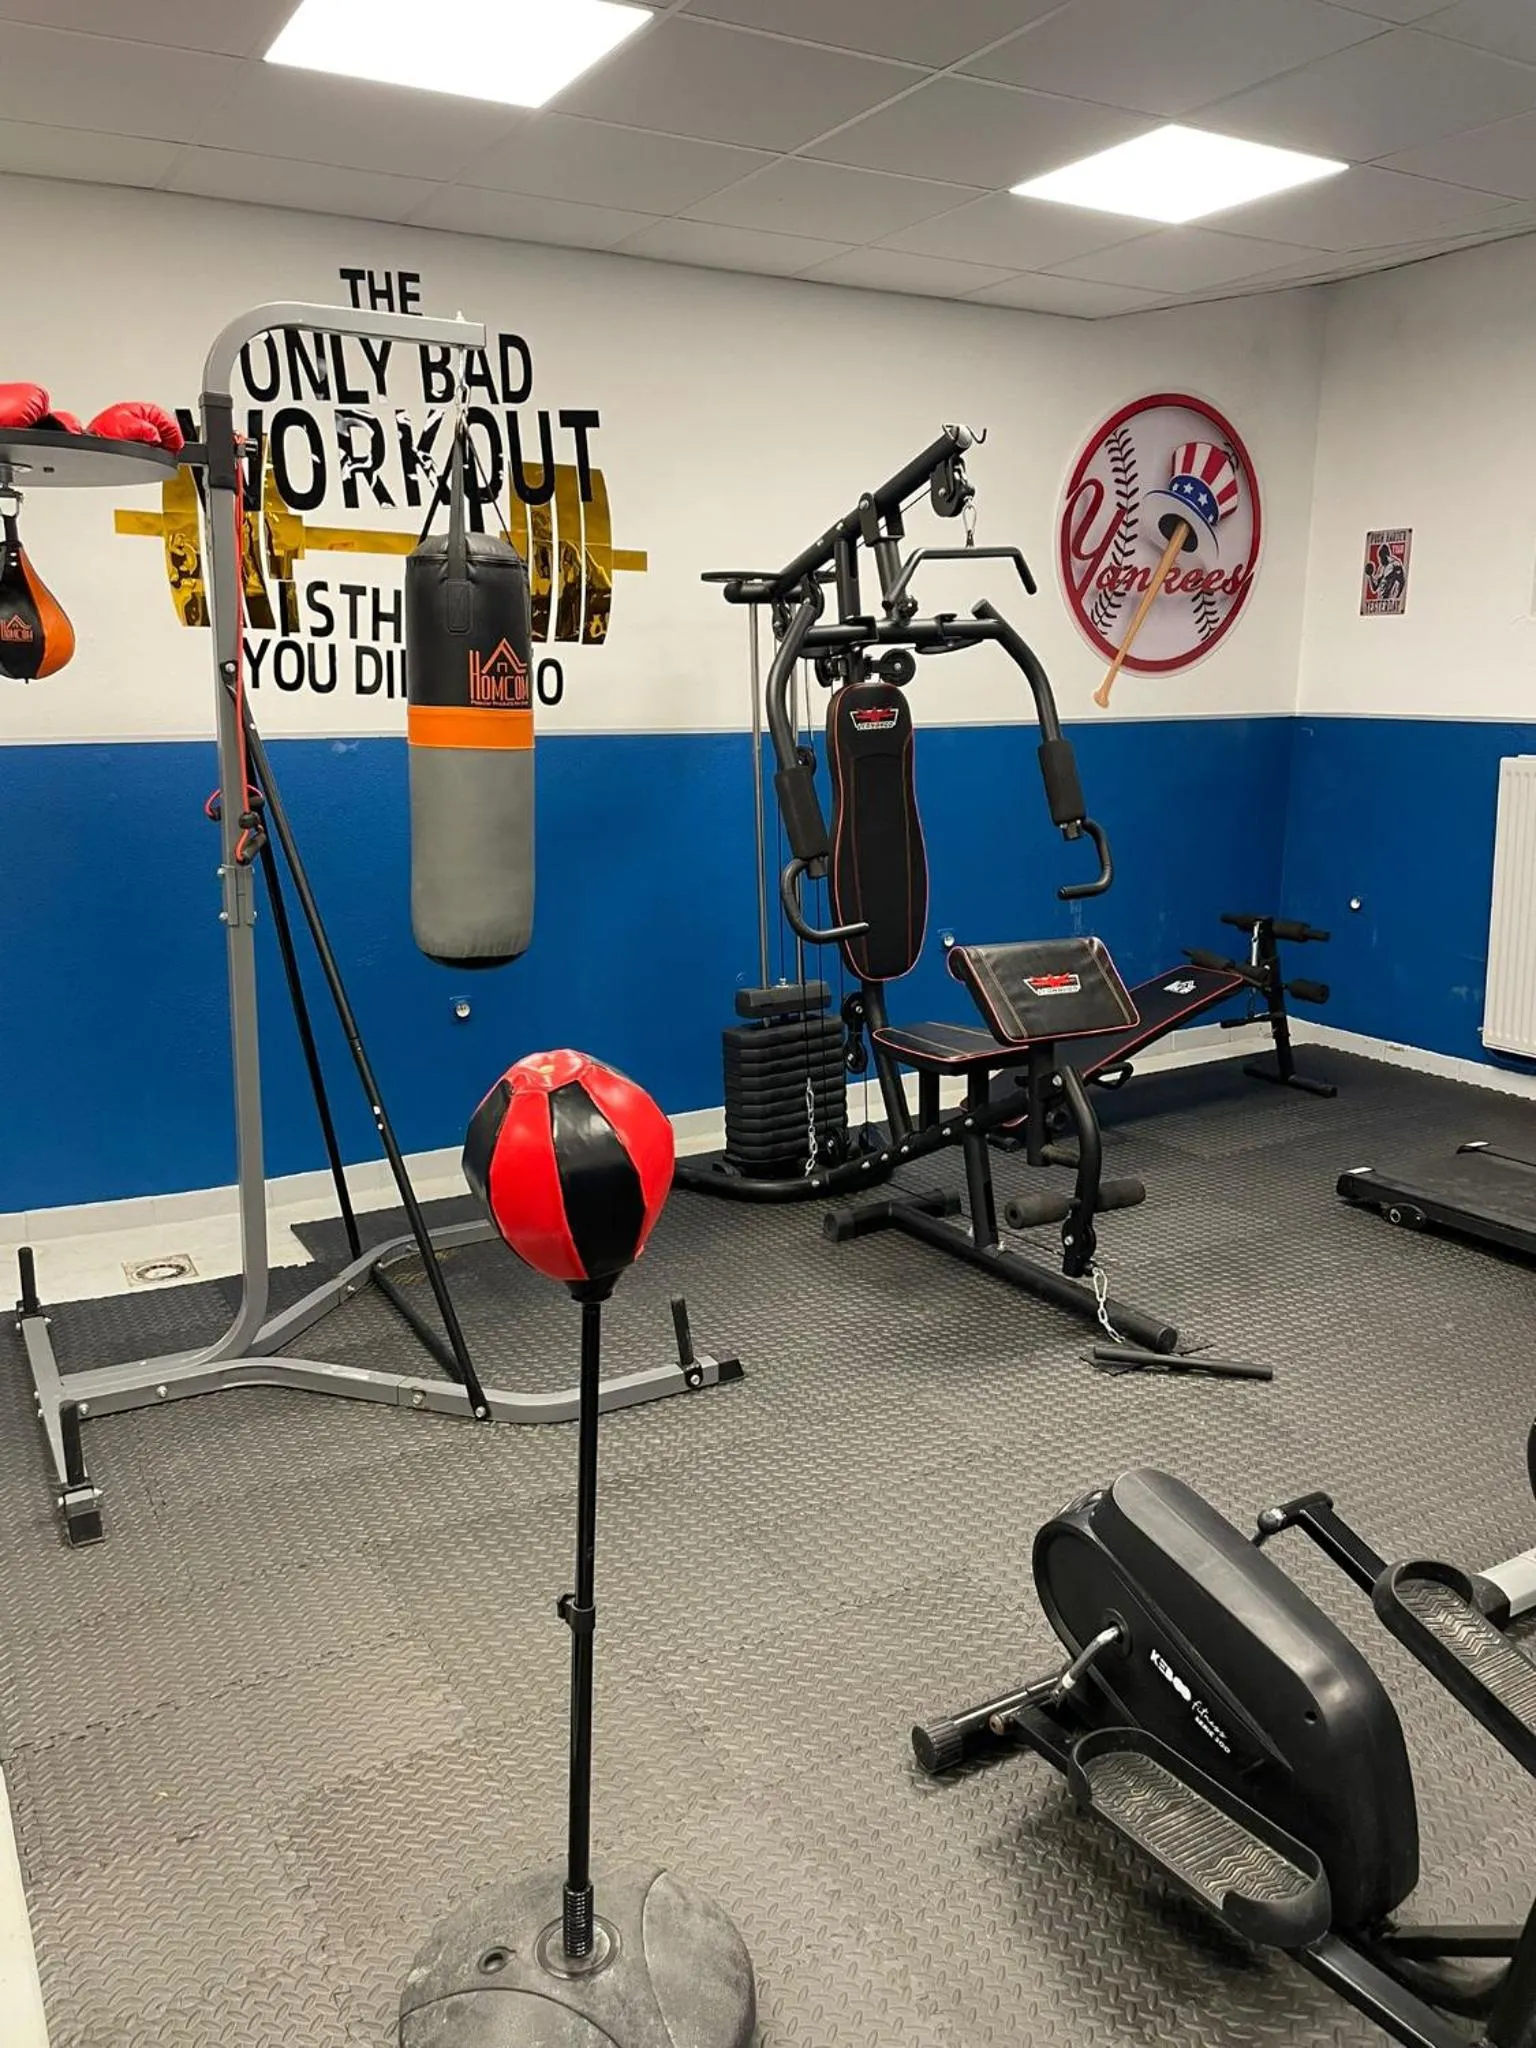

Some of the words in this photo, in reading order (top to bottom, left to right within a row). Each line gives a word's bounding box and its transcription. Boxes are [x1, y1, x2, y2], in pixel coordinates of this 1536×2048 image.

[339, 268, 423, 316] THE
[239, 328, 392, 404] ONLY
[419, 333, 533, 405] BAD
[175, 406, 601, 511] WORKOUT
[1061, 478, 1254, 597] Yankees
[339, 584, 402, 643] TH
[242, 637, 338, 694] YOU
[537, 657, 564, 706] O
